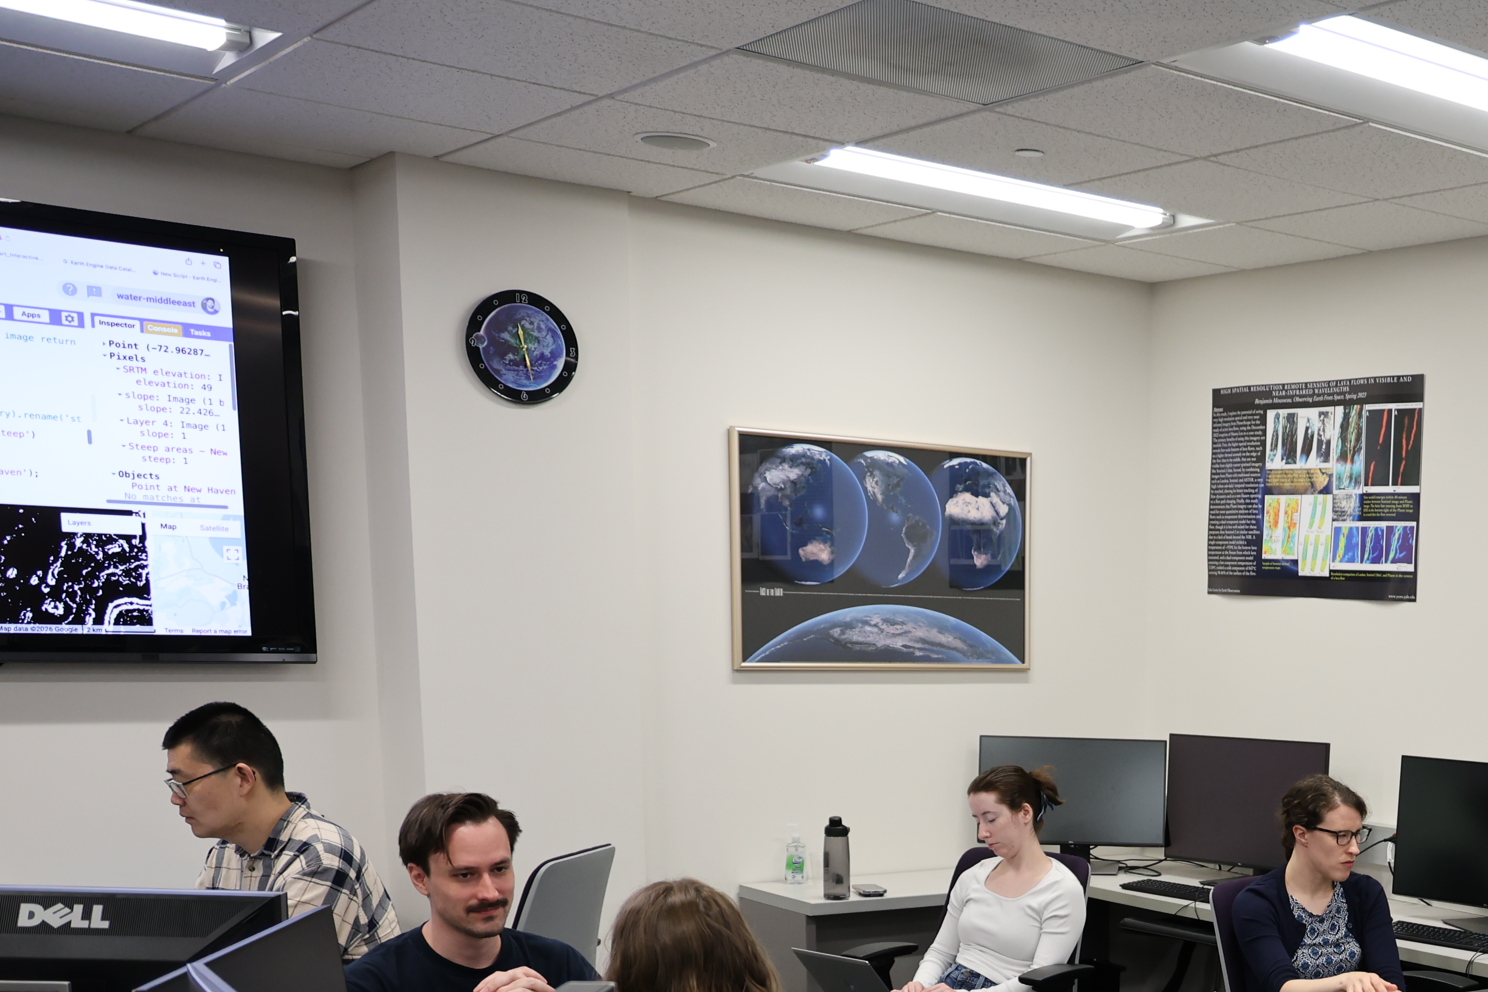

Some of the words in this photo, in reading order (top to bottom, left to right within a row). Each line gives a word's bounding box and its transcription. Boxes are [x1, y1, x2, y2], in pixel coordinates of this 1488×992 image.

[117, 292, 195, 308] water-middleeast
[516, 293, 528, 303] 12
[21, 311, 41, 319] Apps
[99, 320, 135, 329] Inspector
[147, 325, 178, 334] Console
[190, 329, 211, 337] Tasks
[109, 340, 138, 349] Point
[570, 348, 576, 357] 3
[110, 353, 146, 362] Pixels
[123, 366, 146, 374] SRTM
[153, 369, 211, 380] elevation:
[1251, 384, 1283, 392] RESOLUTION
[1272, 388, 1313, 396] NEAR-INFRARED
[1315, 386, 1349, 394] WAVELENGTHS
[521, 392, 528, 400] 6
[127, 418, 156, 428] Layer
[181, 421, 209, 431] Image
[128, 443, 158, 452] Steep
[165, 446, 193, 454] areas
[210, 448, 228, 456] New
[118, 471, 160, 480] Objects
[132, 482, 160, 491] Point
[168, 484, 178, 492] at
[184, 485, 202, 493] New
[208, 486, 235, 495] Haven
[68, 519, 91, 527] Layers
[200, 524, 229, 533] Satellite
[17, 902, 111, 929] DELL
